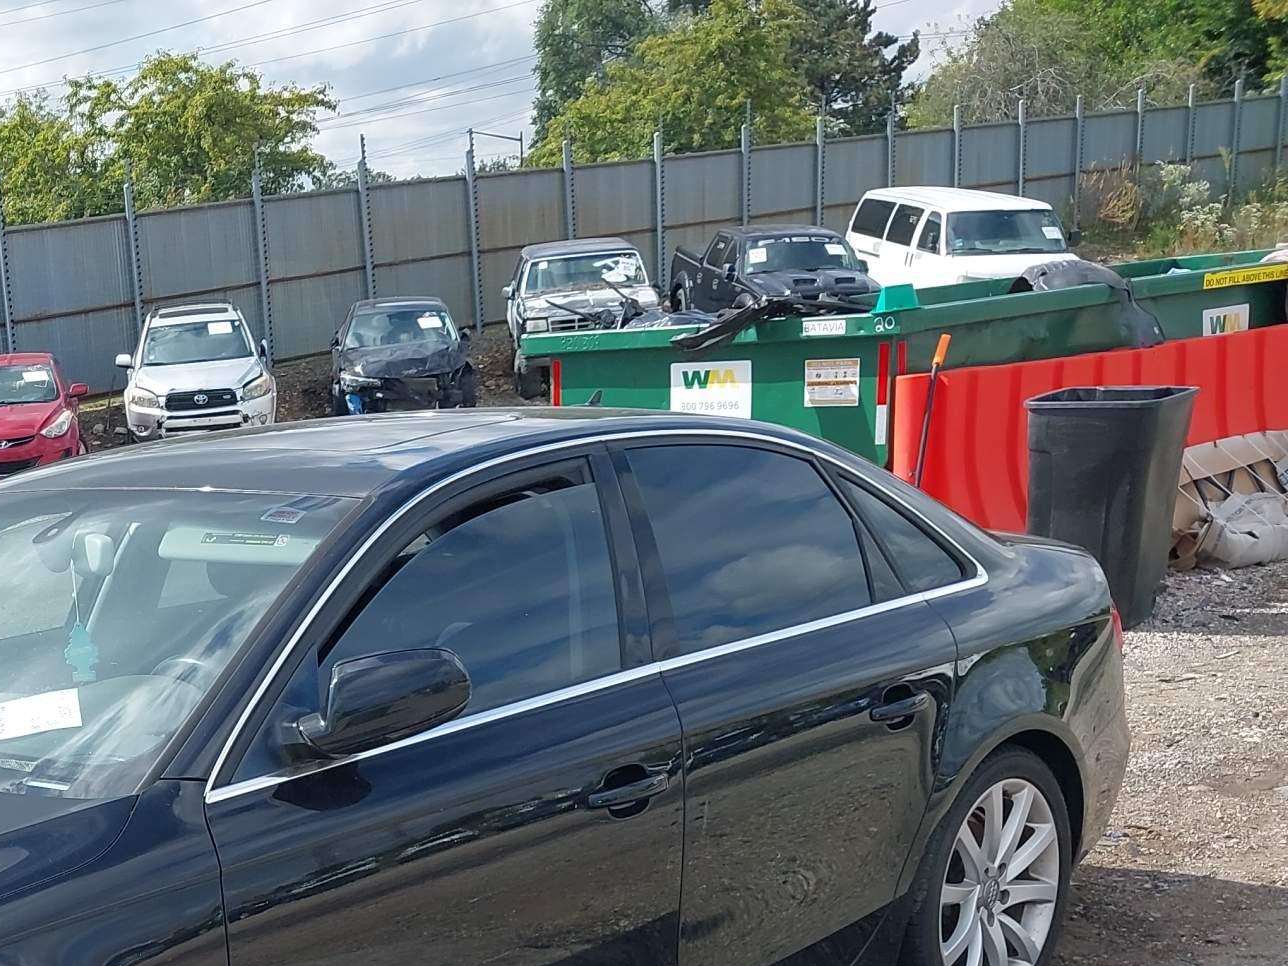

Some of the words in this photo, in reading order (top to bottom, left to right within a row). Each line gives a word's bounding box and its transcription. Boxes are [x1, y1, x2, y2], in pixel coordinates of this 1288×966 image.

[1205, 278, 1215, 288] DO
[1215, 276, 1227, 286] NOT
[1229, 274, 1241, 284] FILL
[1241, 271, 1262, 282] ABOVE
[1262, 270, 1275, 280] THIS
[803, 321, 845, 333] BATAVIA
[873, 315, 896, 333] 20
[1209, 312, 1241, 334] WM
[681, 368, 740, 390] WM
[698, 402, 716, 411] 796
[716, 401, 740, 411] 9696
